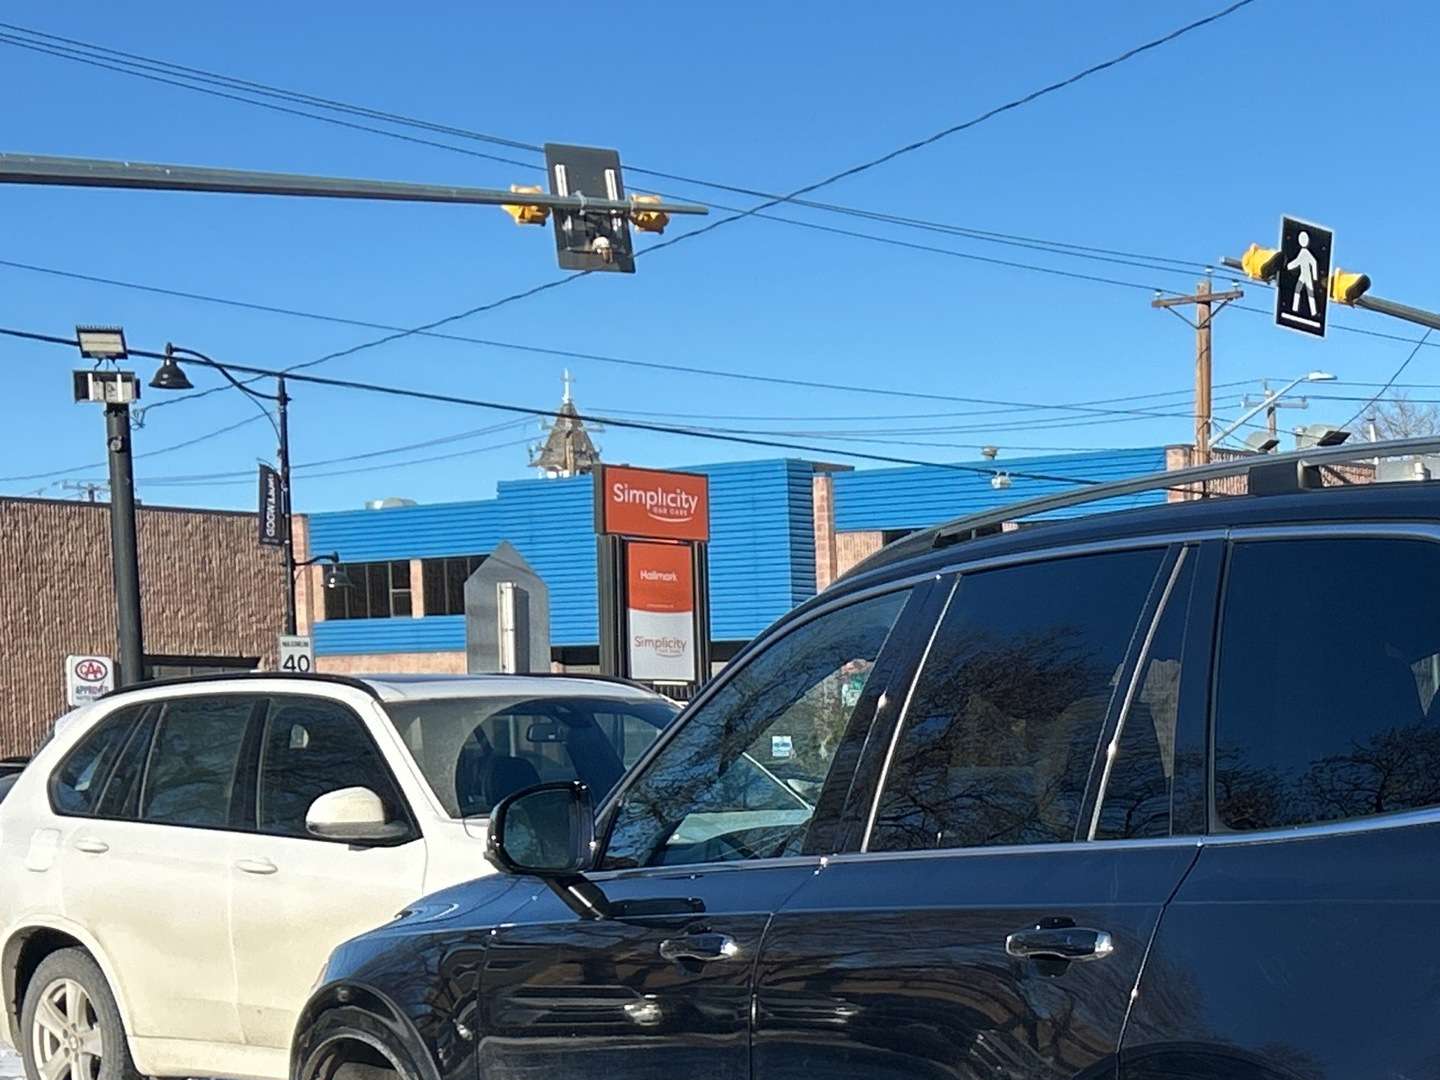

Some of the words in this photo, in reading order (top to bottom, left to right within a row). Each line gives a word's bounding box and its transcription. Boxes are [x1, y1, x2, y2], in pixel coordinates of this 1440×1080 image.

[613, 482, 698, 515] Simplicity
[640, 569, 678, 582] Hallmark
[634, 636, 687, 652] Simplicity
[80, 661, 103, 679] CAA
[283, 654, 310, 673] 40
